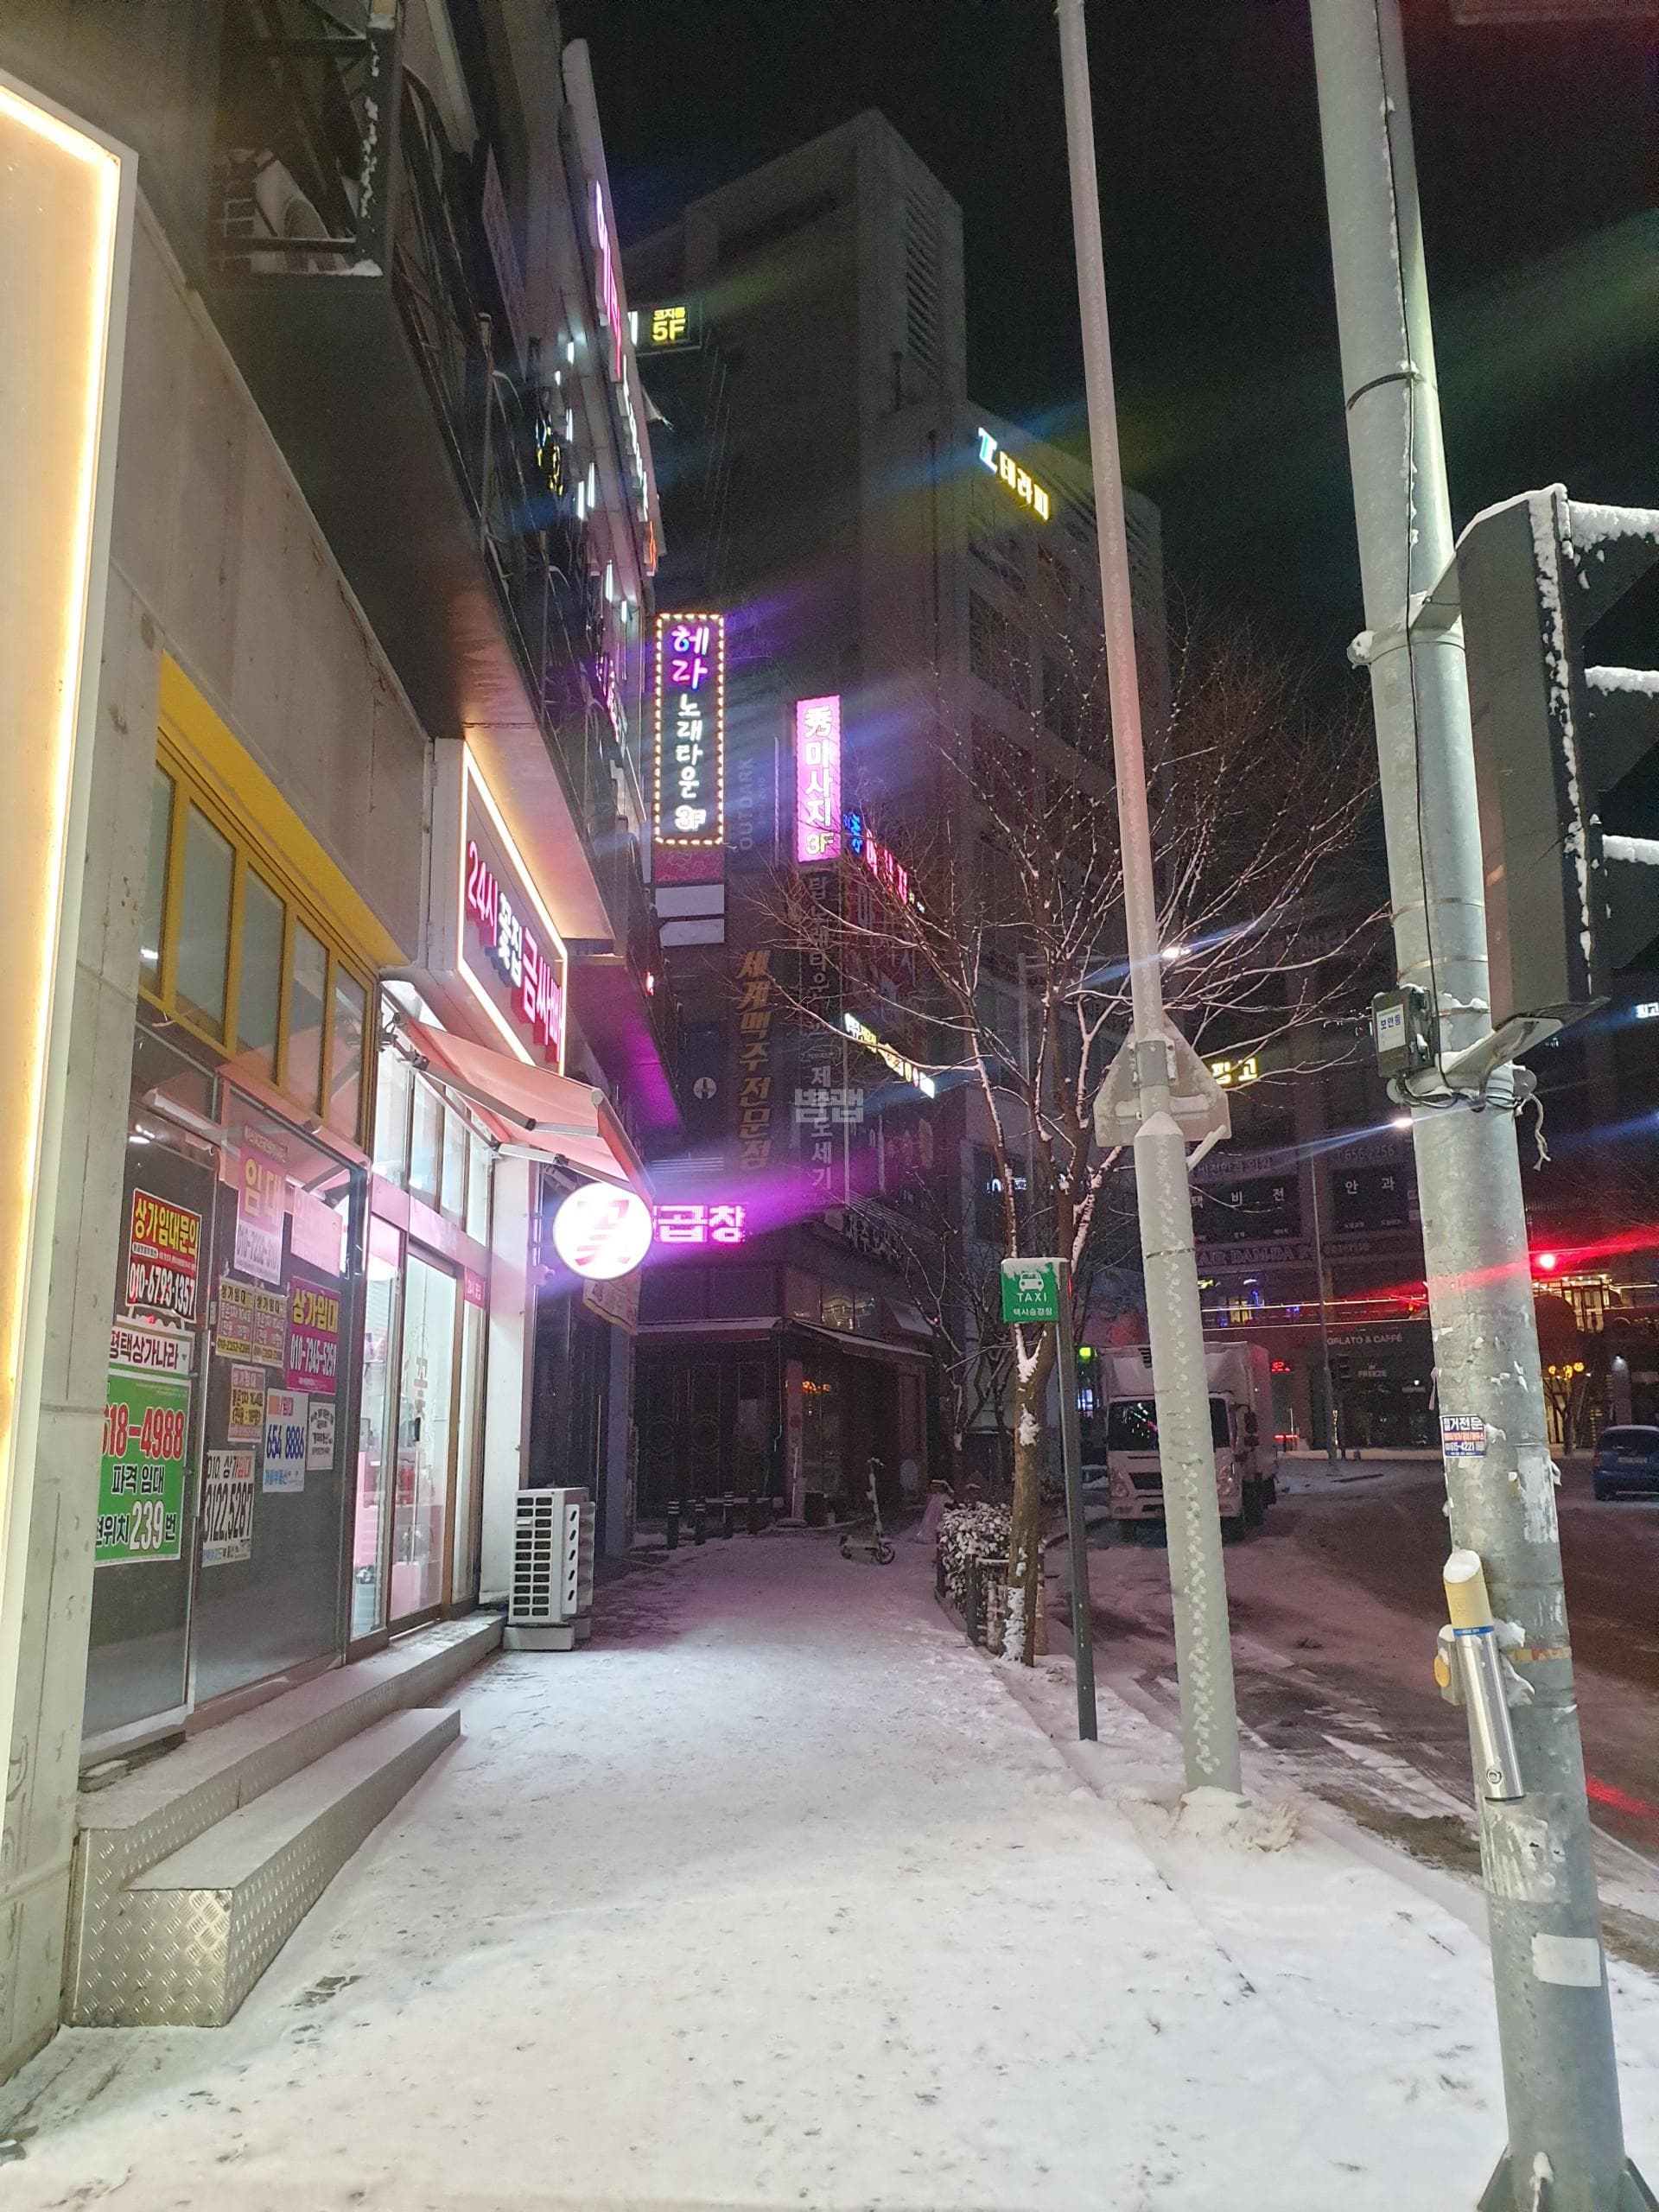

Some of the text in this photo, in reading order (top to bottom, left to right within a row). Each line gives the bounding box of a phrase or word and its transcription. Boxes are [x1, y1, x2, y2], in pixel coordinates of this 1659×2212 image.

[652, 318, 686, 341] 5F
[671, 626, 709, 690] 헤라
[675, 693, 703, 798] 노래타운
[674, 804, 707, 832] 3F
[804, 830, 835, 855] 3F
[467, 840, 499, 947] 24시
[135, 1198, 200, 1259] 상가임대문의
[129, 1262, 195, 1316] 010-6793-1357
[1017, 1292, 1046, 1302] TAXI
[293, 1287, 340, 1333] 상가임대
[1326, 1336, 1363, 1345] GELATO
[111, 1463, 165, 1495] 파격 임대
